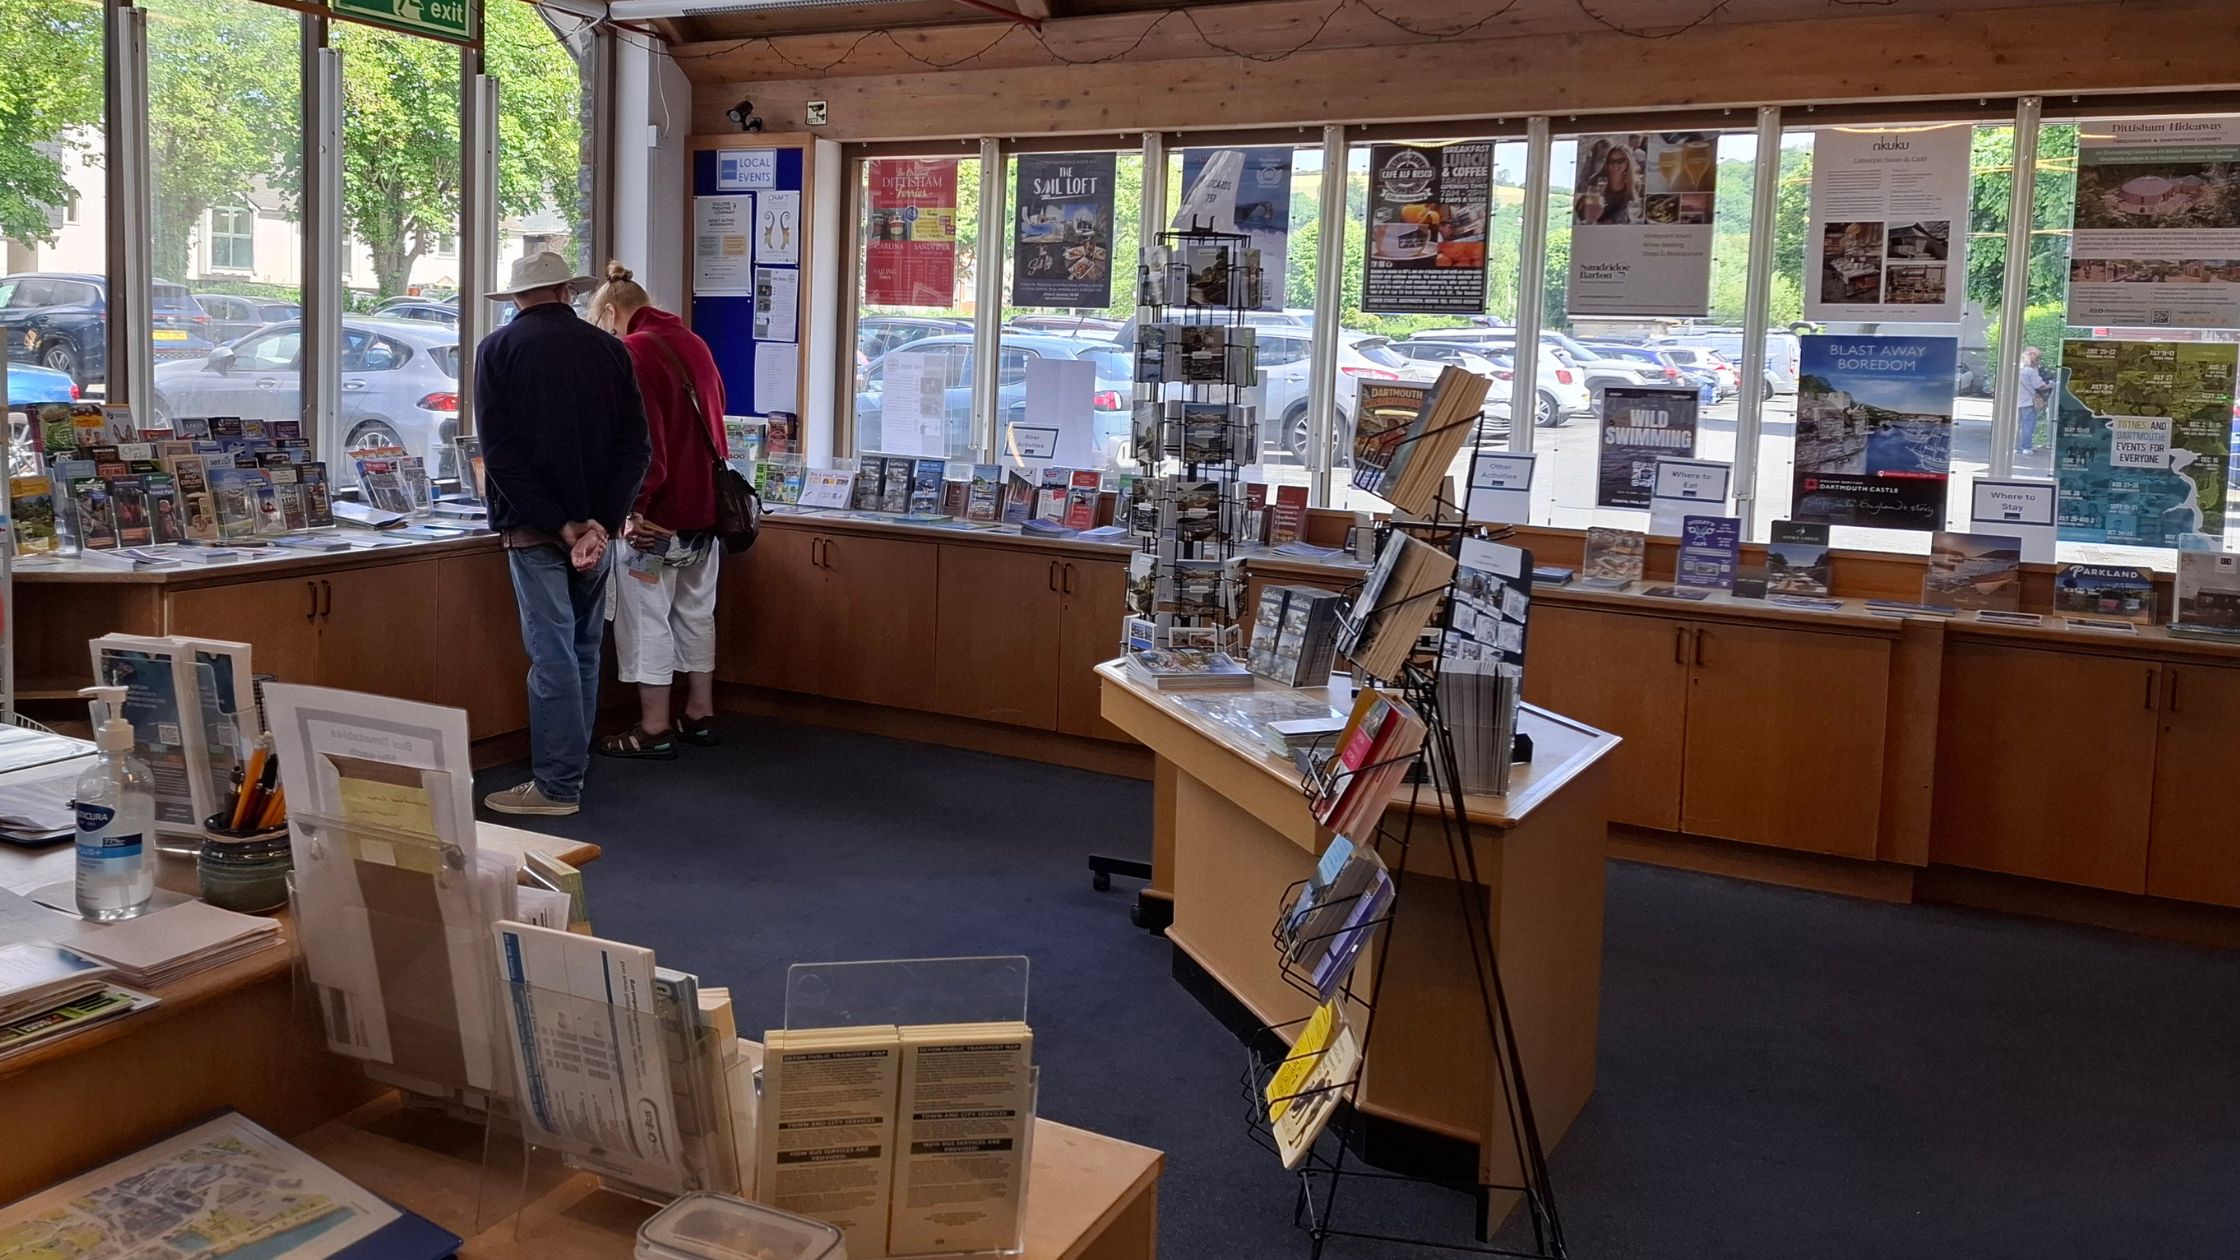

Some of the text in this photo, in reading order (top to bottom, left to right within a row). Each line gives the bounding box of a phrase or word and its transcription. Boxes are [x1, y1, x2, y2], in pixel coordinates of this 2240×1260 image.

[430, 1, 463, 24] exit
[2112, 122, 2223, 133] Dittisham Hideaway
[1872, 136, 1910, 151] nkuku
[1442, 145, 1490, 154] BREAKFAST
[740, 159, 771, 168] LOCAL
[1443, 153, 1489, 167] LUNCH
[739, 172, 771, 182] EVENTS
[1060, 167, 1073, 178] THE
[1382, 170, 1398, 179] CAFÉ
[1442, 167, 1488, 177] & COFFEE
[882, 177, 942, 188] DITTISHAM
[1033, 177, 1099, 195] SAIL LOFT
[1580, 263, 1631, 277] Sandridge
[1580, 271, 1613, 280] Barton
[1829, 344, 1926, 357] BLAST AWAY
[1838, 359, 1916, 371] BOREDOM
[1371, 388, 1423, 400] DARTMOUTH
[1630, 409, 1669, 428] WILD
[2117, 420, 2167, 431] TOTNES AND
[1605, 427, 1693, 449] SWIMMING
[2117, 431, 2166, 441] DARTMOUTH
[2116, 441, 2165, 453] EVENTS FOR
[2119, 453, 2160, 464] EVERYONE
[1490, 463, 1513, 471] Other
[1481, 472, 1518, 480] Activities
[1672, 471, 1712, 480] Where to
[1820, 484, 1899, 494] DARTMOUTH CASTLE
[1990, 491, 2036, 502] Where to
[2002, 503, 2024, 513] Stay
[2069, 565, 2138, 579] PARKLAND
